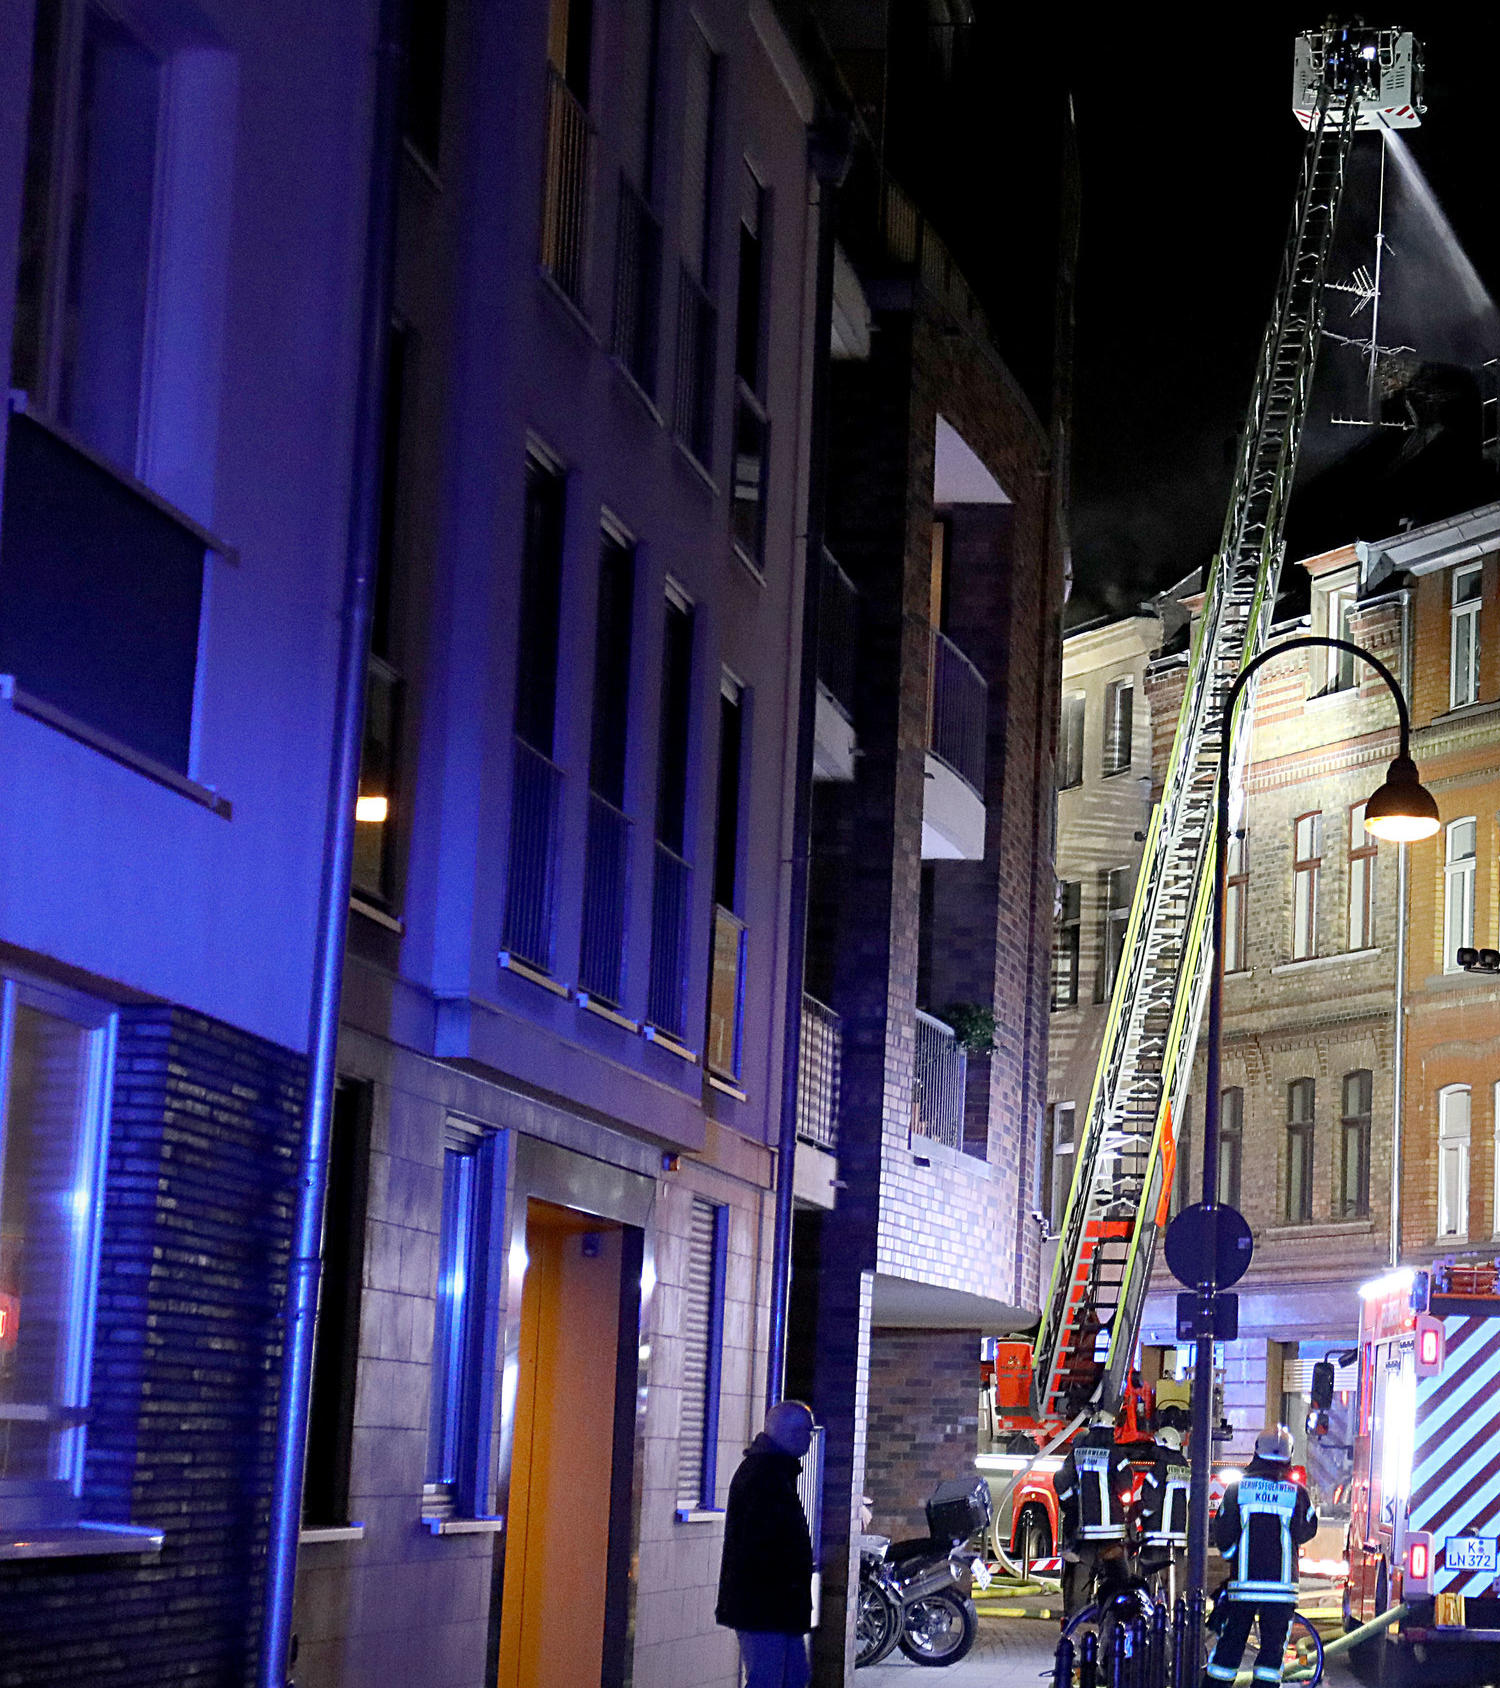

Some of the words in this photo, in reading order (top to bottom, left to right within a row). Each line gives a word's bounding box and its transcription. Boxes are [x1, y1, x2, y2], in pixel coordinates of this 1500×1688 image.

[1255, 1492, 1279, 1503] KÖLN
[1468, 1541, 1476, 1553] K
[1449, 1552, 1465, 1567] LN
[1468, 1554, 1491, 1567] 372
